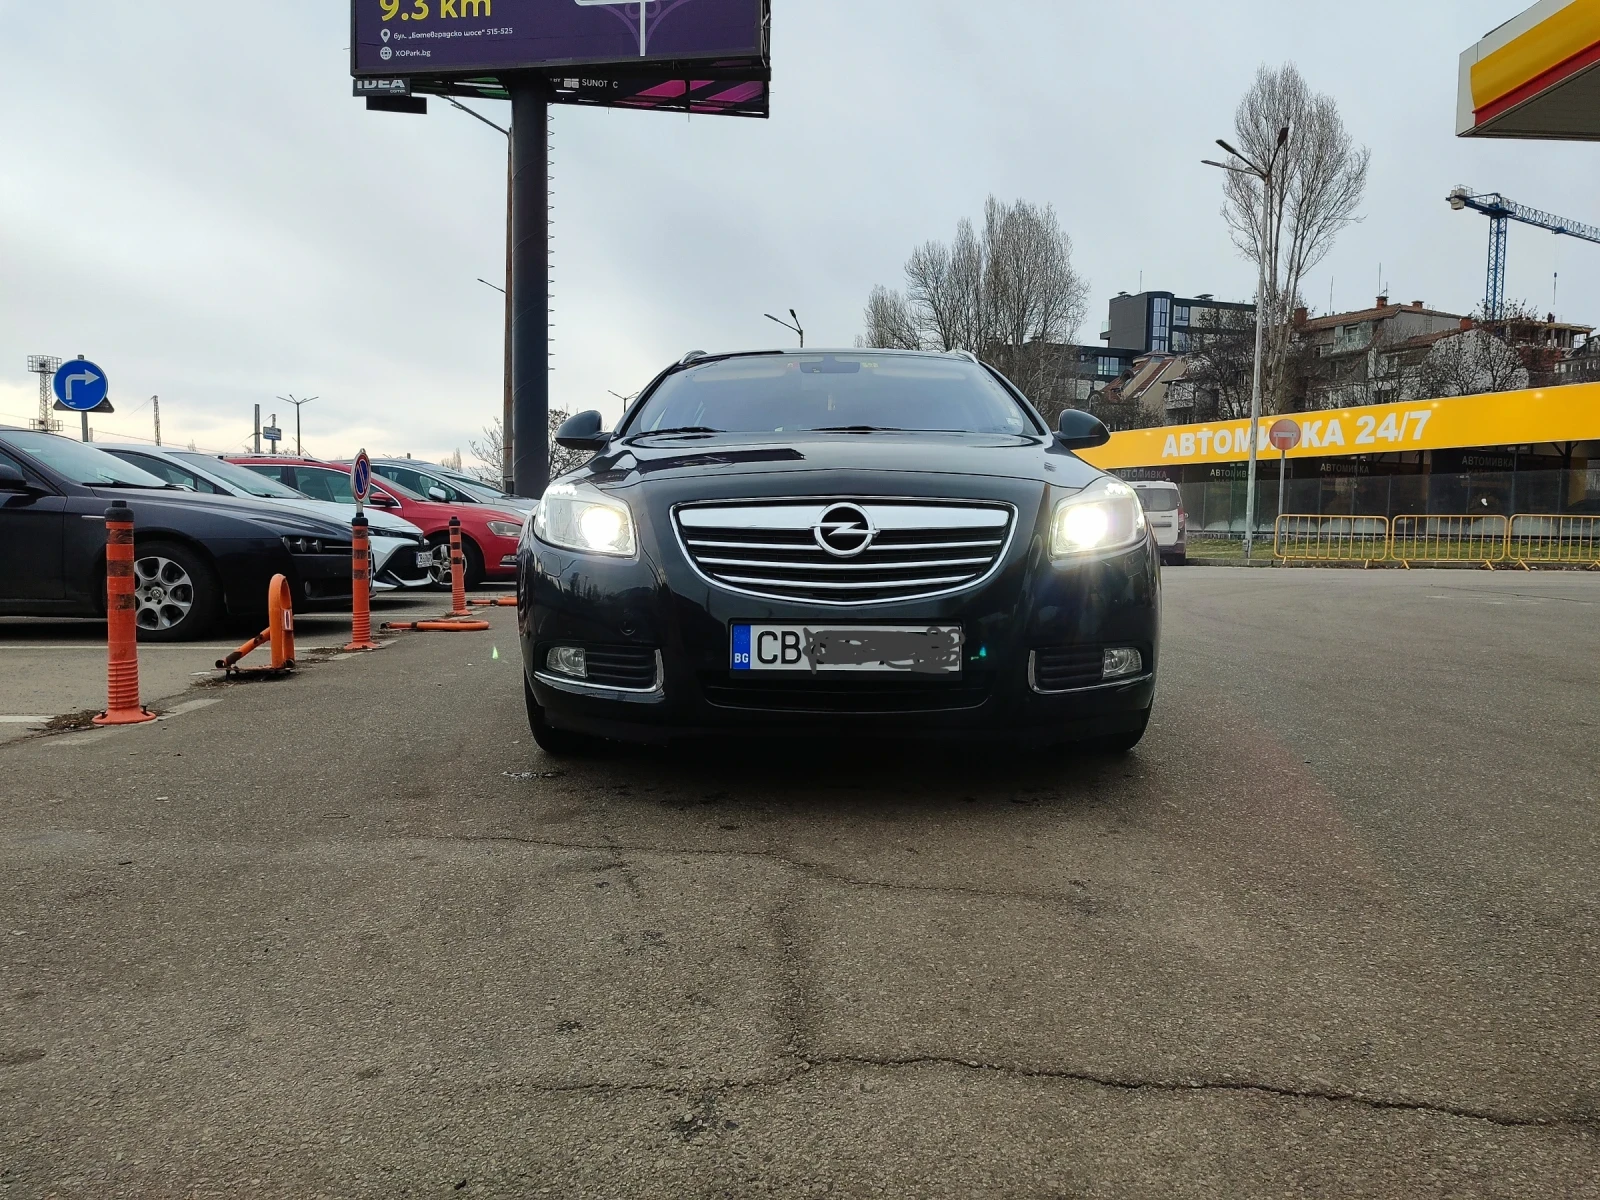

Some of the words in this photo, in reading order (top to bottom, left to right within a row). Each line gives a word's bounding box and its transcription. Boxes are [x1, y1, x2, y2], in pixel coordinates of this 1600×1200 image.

[380, 0, 430, 21] 9.3
[440, 0, 491, 19] km
[486, 27, 513, 36] 515-525
[395, 49, 431, 57] XOPark.bg
[357, 79, 405, 89] IDEA
[581, 78, 618, 89] SUNOTC
[1161, 419, 1345, 458] АВТОМИКА
[1355, 409, 1432, 445] 24/7
[1460, 455, 1514, 468] АВТОМИВКА
[757, 630, 802, 664] CB
[734, 653, 749, 663] BG
